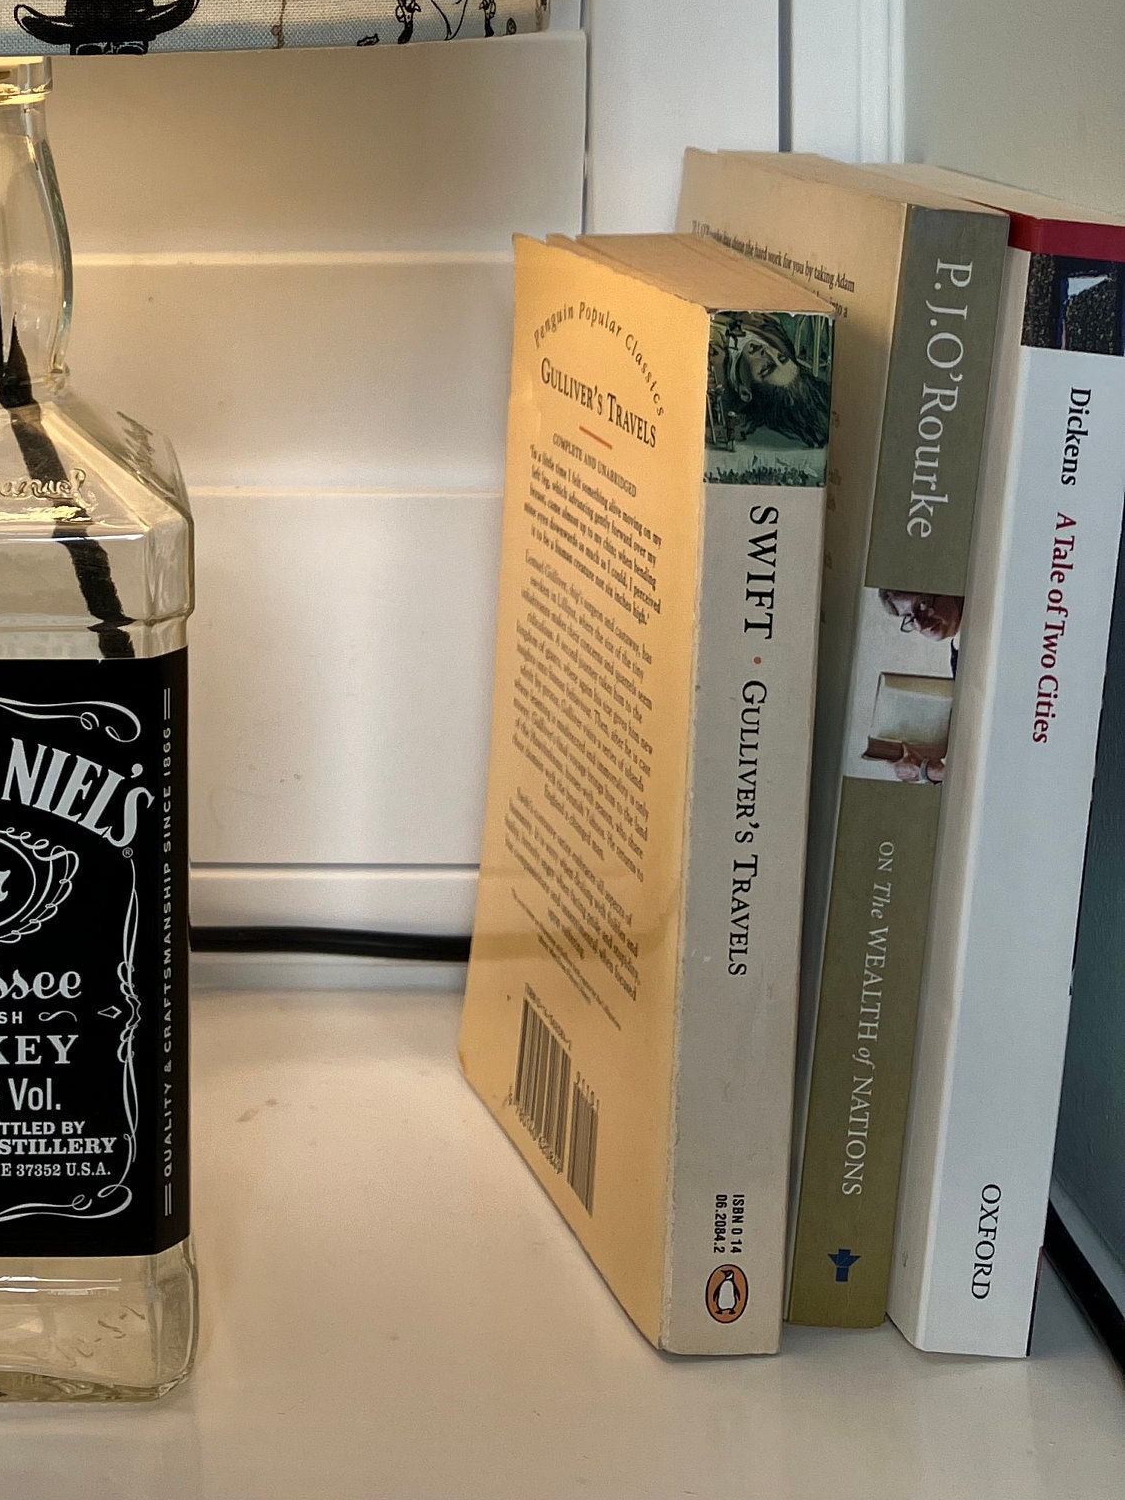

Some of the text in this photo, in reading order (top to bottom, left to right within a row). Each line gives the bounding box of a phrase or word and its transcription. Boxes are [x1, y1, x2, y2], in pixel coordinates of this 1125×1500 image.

[835, 272, 855, 293] Adam
[533, 301, 666, 418] Penguin Popular Classics
[1061, 386, 1093, 487] Dickens
[743, 504, 780, 641] SWIFT
[1032, 512, 1078, 745] A Tale of Two Cities
[162, 726, 174, 1178] QUALITY & CRAFTSMANSHIP SINCE 1866
[841, 841, 896, 1197] ON The WEALTH of NATIONS
[8, 1077, 62, 1112] Vol.
[61, 1121, 86, 1136] BY
[16, 1162, 61, 1178] 37352
[66, 1161, 112, 1178] U.S.A.
[731, 1193, 745, 1224] ISBN
[713, 1193, 728, 1254] 06.2084.2
[730, 1239, 743, 1254] 14
[971, 1183, 1002, 1301] OXFORD
